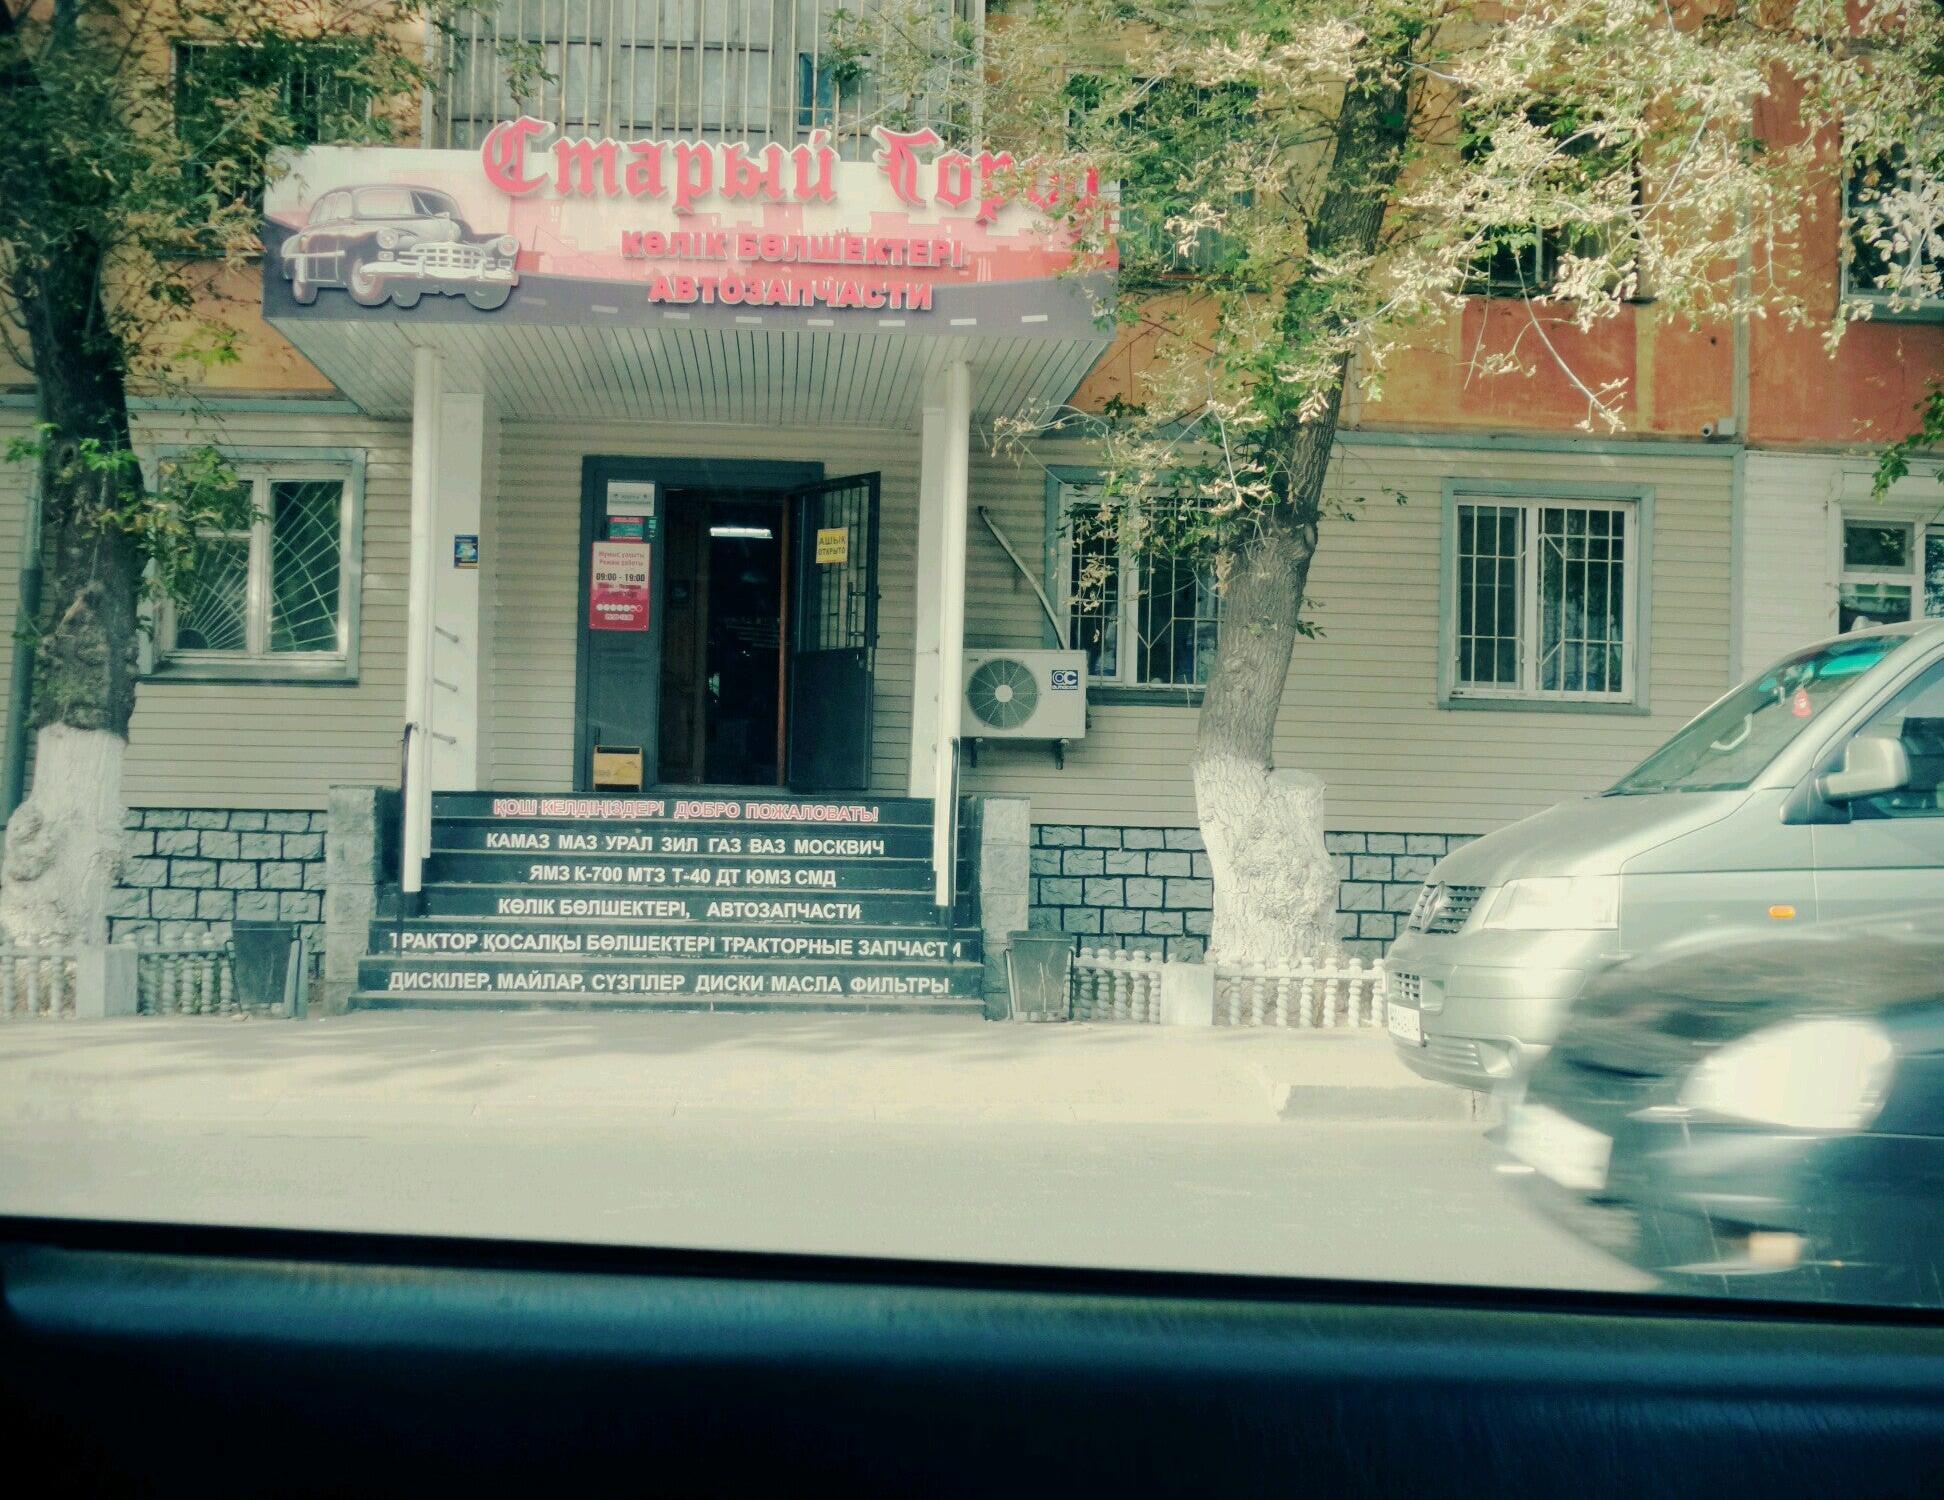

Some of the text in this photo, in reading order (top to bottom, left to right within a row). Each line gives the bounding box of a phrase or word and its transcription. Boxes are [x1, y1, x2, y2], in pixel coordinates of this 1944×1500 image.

[482, 114, 842, 216] Старый
[621, 230, 964, 269] КӨЛІК БӨЛШЕКТЕРІ
[648, 274, 934, 311] АВТОЗАПЧАСТИ
[596, 572, 617, 582] 09:00
[625, 573, 646, 583] 19:00
[674, 801, 741, 819] ДОБРО
[745, 803, 879, 823] ПОЖАЛОВАТЬ!
[486, 832, 885, 855] КАМАЗ МАЗ УРАЛ ЗИЛ ГАЗ ВАЗ МОСКВИЧ
[530, 865, 837, 887] ЯМЗ К-700 МТЗ Т-40 ДТ ЮМЗ СМД
[498, 898, 862, 920] КӨЛІК БӨЛШЕКТЕРІ, АВТОЗАПЧАСТИ
[389, 932, 479, 950] ТРАКТОР
[483, 933, 581, 953] ҚОСАЛҚЫ
[586, 934, 715, 953] БӨЛШЕКТЕРІ
[721, 936, 853, 955] ТРАКТОРНЫЕ
[388, 970, 949, 993] ДИСКІЛЕР, МАЙЛАР, СҮЗГІЛЕР ДИСКИ МАСЛА ФИЛЬТРЫ
